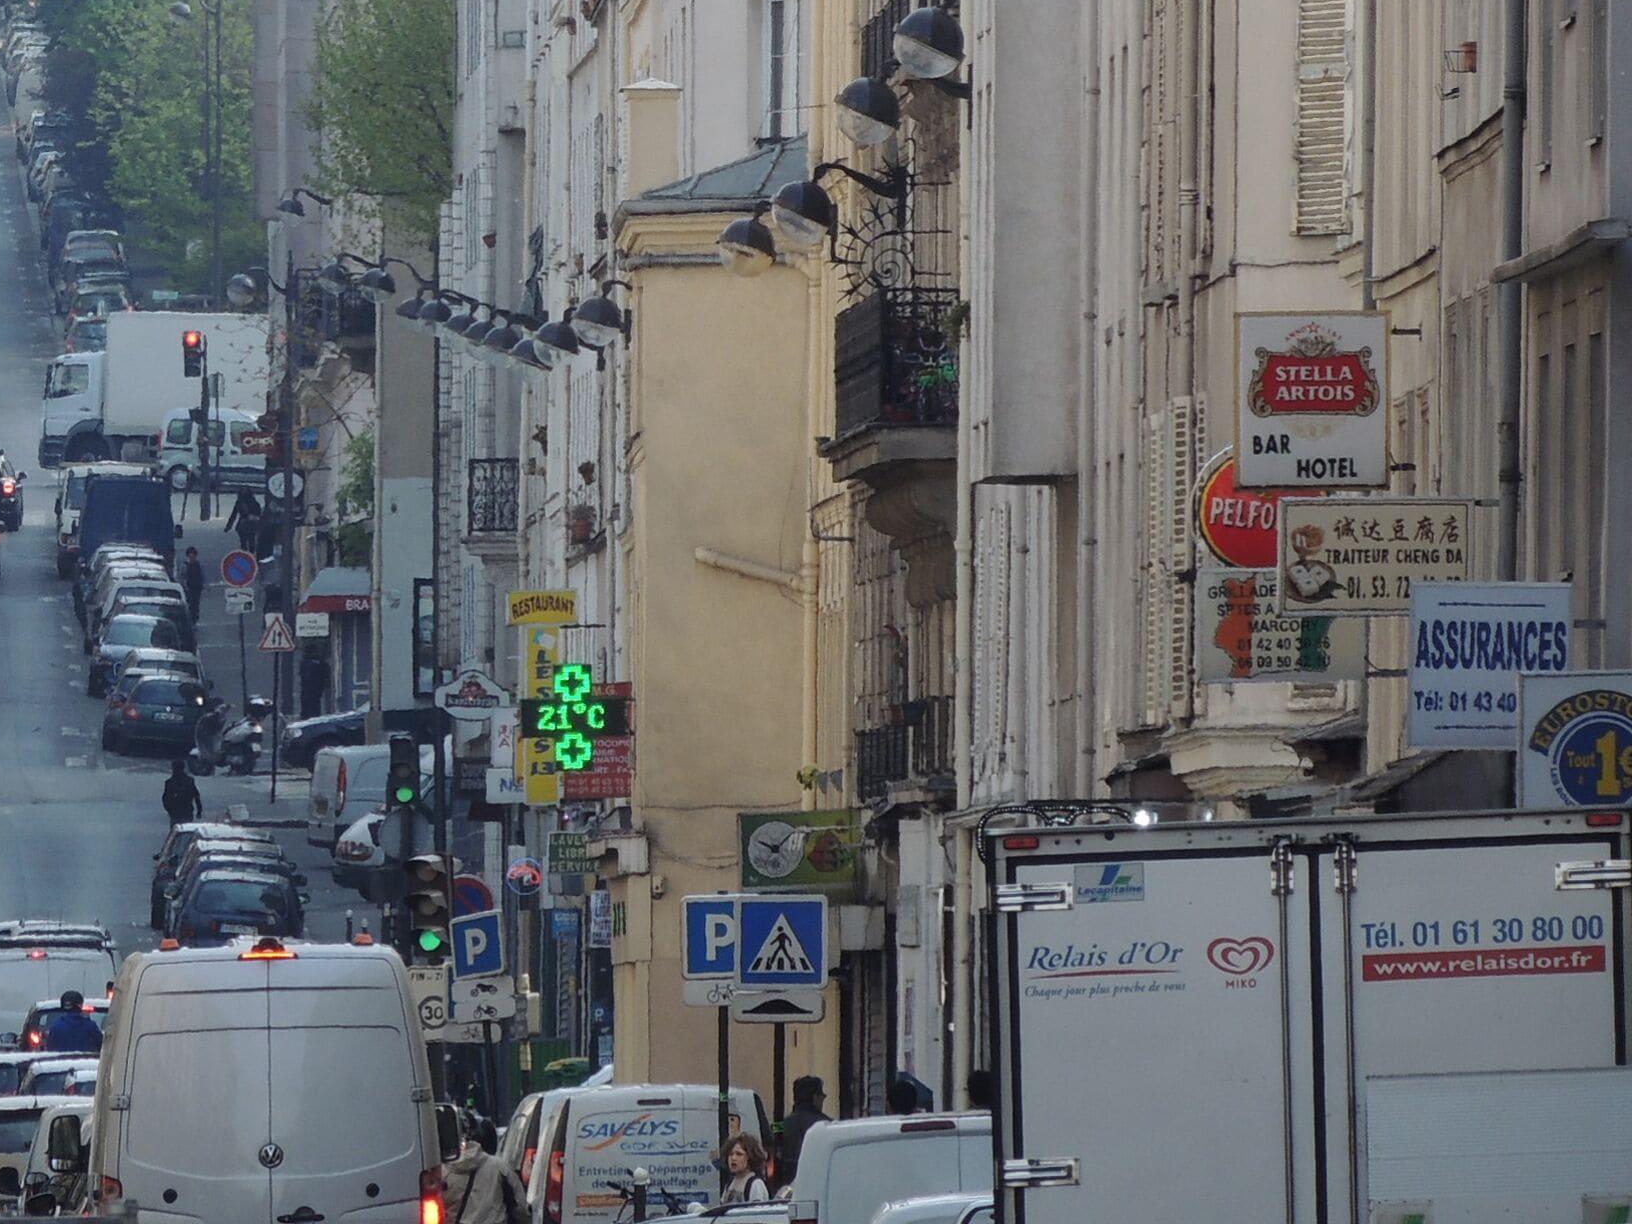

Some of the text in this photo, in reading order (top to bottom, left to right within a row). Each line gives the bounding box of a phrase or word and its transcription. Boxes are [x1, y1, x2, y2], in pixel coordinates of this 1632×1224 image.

[1275, 365, 1353, 382] STELLA
[1275, 385, 1355, 401] ARTOIS
[1252, 433, 1292, 455] BAR
[1296, 457, 1358, 479] HOTEL
[1209, 497, 1278, 531] PELFO
[1324, 549, 1463, 565] TRAITEUR CHENG DA
[346, 599, 370, 611] BRA
[512, 595, 575, 619] RESTAURANT
[1415, 619, 1567, 671] ASSURANCES
[1449, 691, 1467, 712] 01
[1473, 691, 1493, 712] 43
[1496, 691, 1517, 713] 40
[537, 703, 605, 730] 21°C
[558, 848, 587, 858] LIBR
[1077, 885, 1143, 897] Lecapitaine
[705, 913, 736, 961] P
[1360, 915, 1604, 949] Tél. 01 61 30 80 00
[464, 927, 487, 966] P
[1027, 941, 1184, 972] Relais d'Or
[1373, 950, 1593, 975] www.relaisdor.fr
[1025, 982, 1186, 1000] Chaque jour plus proche de vous
[1225, 978, 1257, 989] MIKO
[424, 1005, 444, 1021] 30
[577, 1120, 680, 1139] SAVELYS
